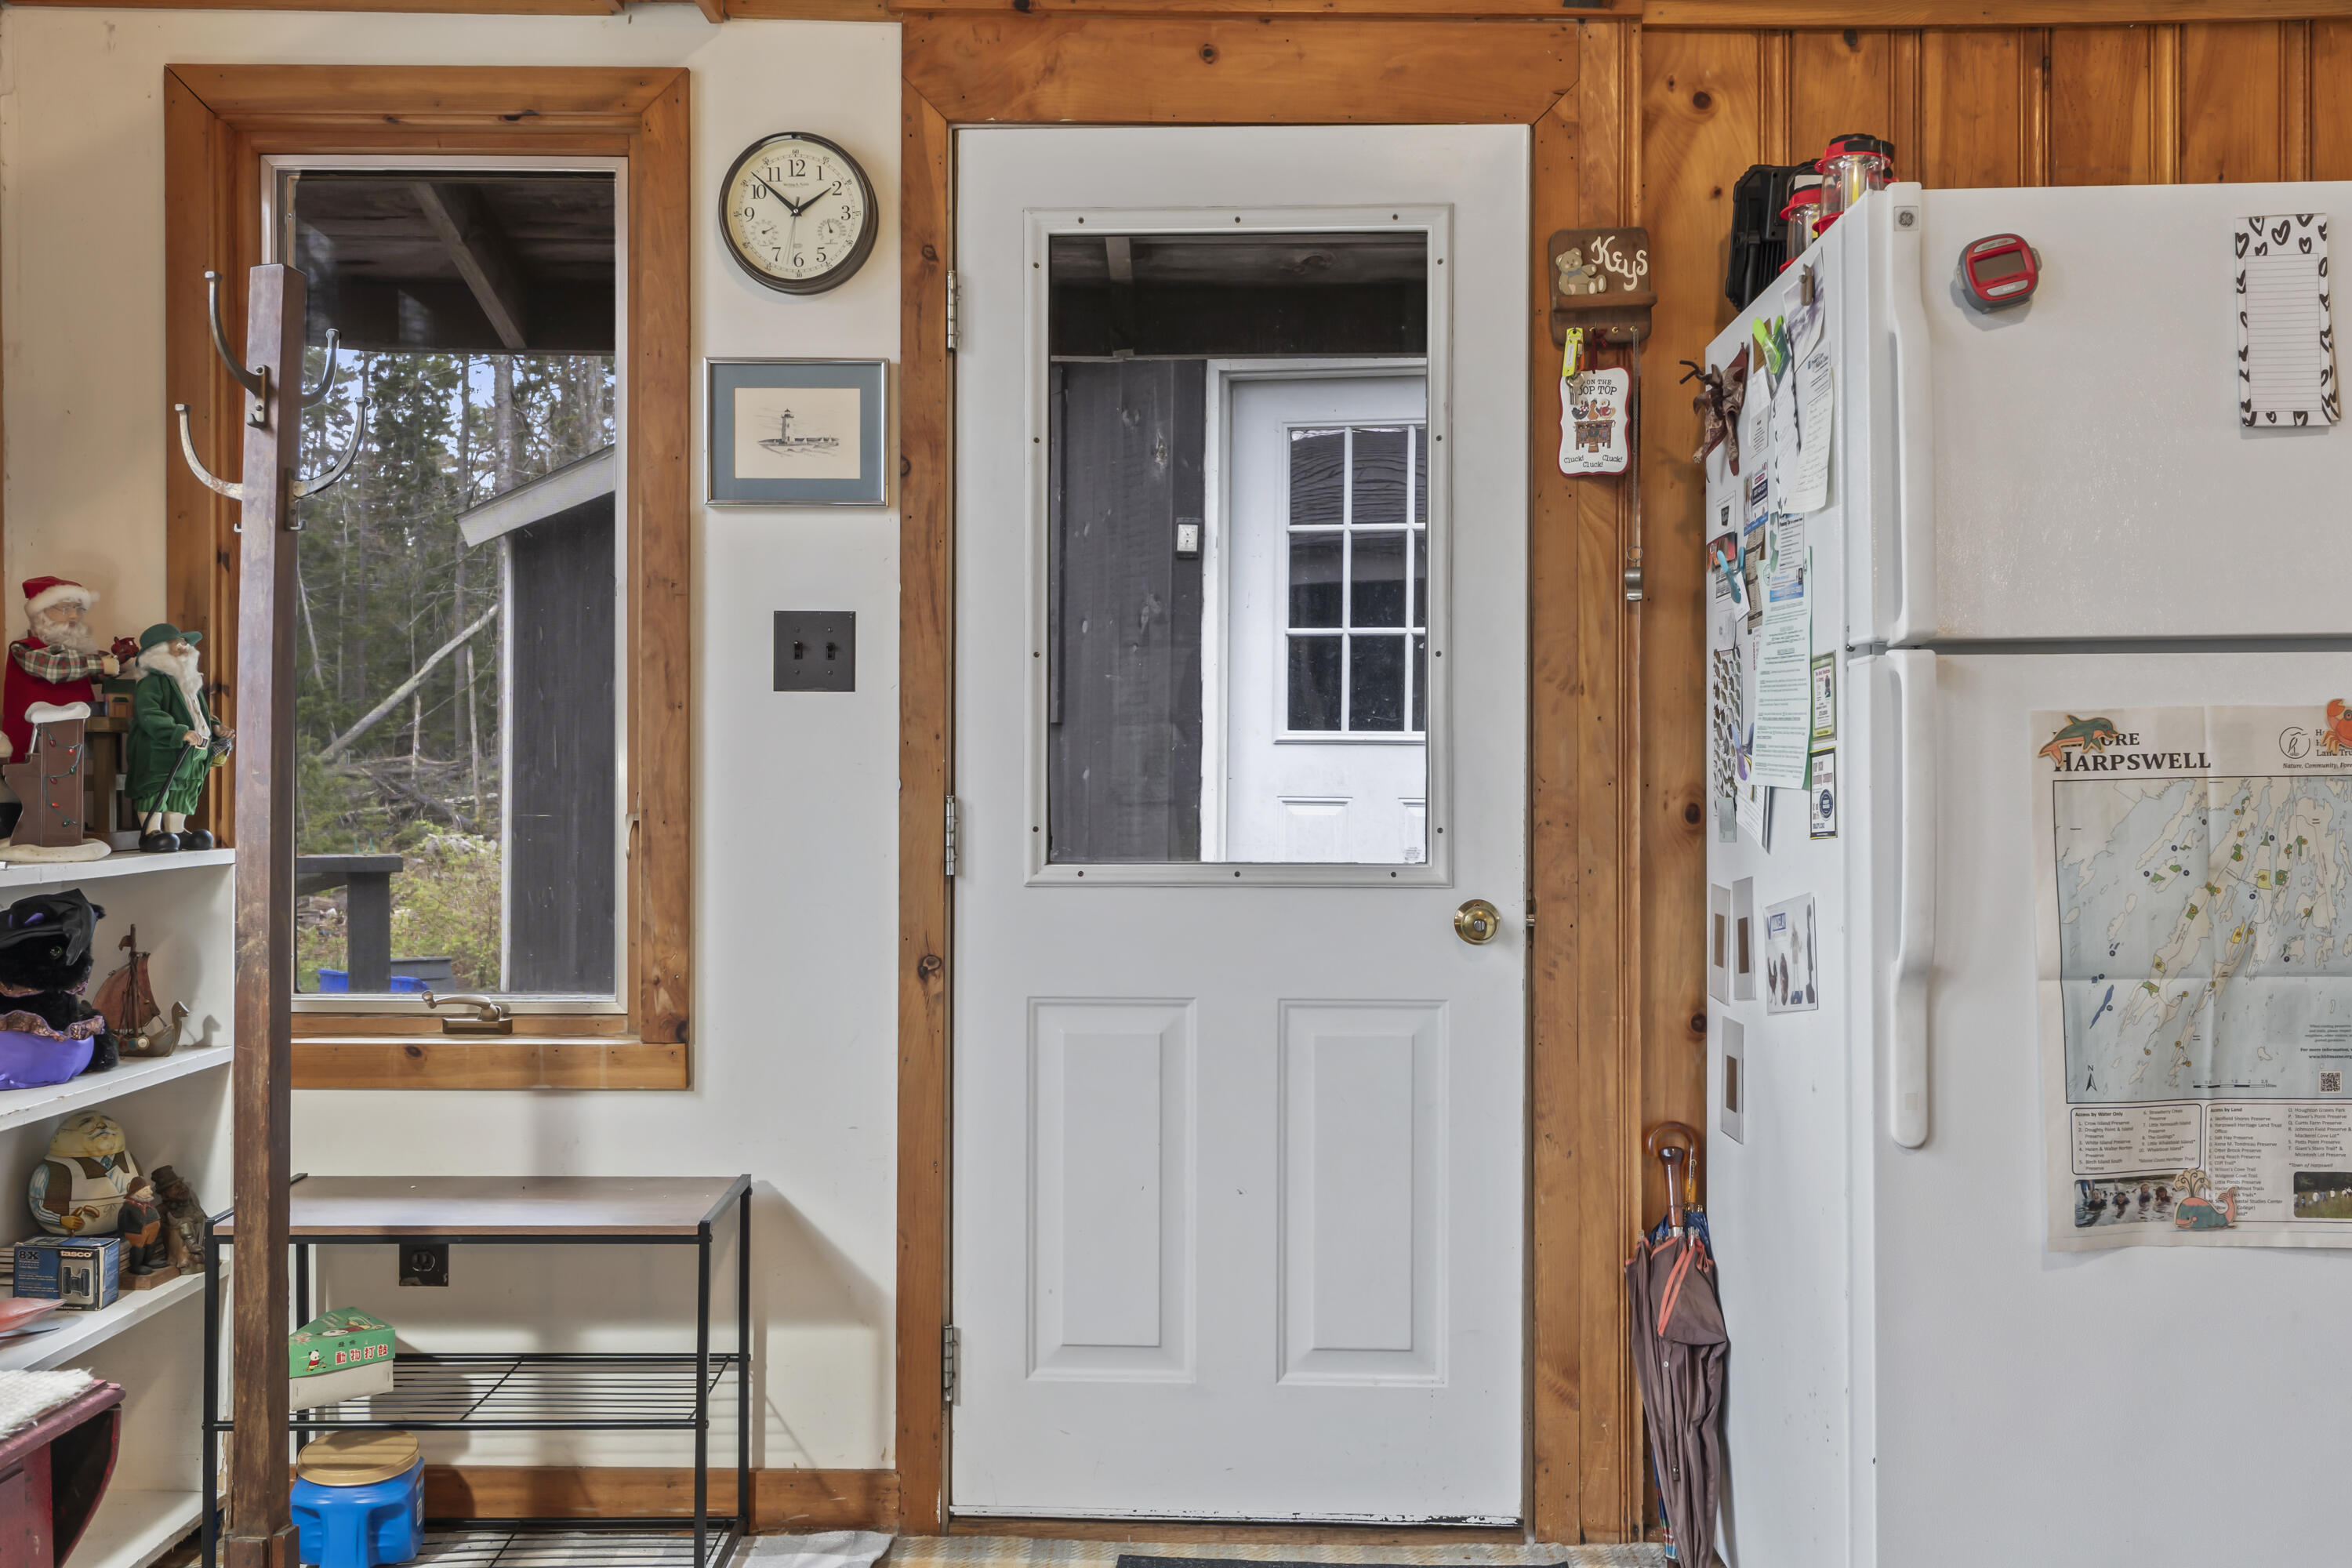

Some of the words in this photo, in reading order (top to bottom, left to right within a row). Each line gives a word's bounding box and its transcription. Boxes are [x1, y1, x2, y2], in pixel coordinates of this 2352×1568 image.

[766, 167, 782, 182] 11
[788, 159, 806, 176] 12
[816, 165, 824, 180] 1
[750, 184, 767, 199] 10
[832, 181, 842, 196] 2
[744, 207, 754, 222] 9
[841, 205, 851, 220] 3
[771, 247, 781, 262] 7
[793, 252, 804, 267] 6
[816, 247, 826, 262] 5
[1591, 235, 1648, 292] Keys
[1598, 385, 1617, 395] TOP
[1563, 455, 1584, 464] Cluck!
[2053, 751, 2211, 772] HARPSWELL
